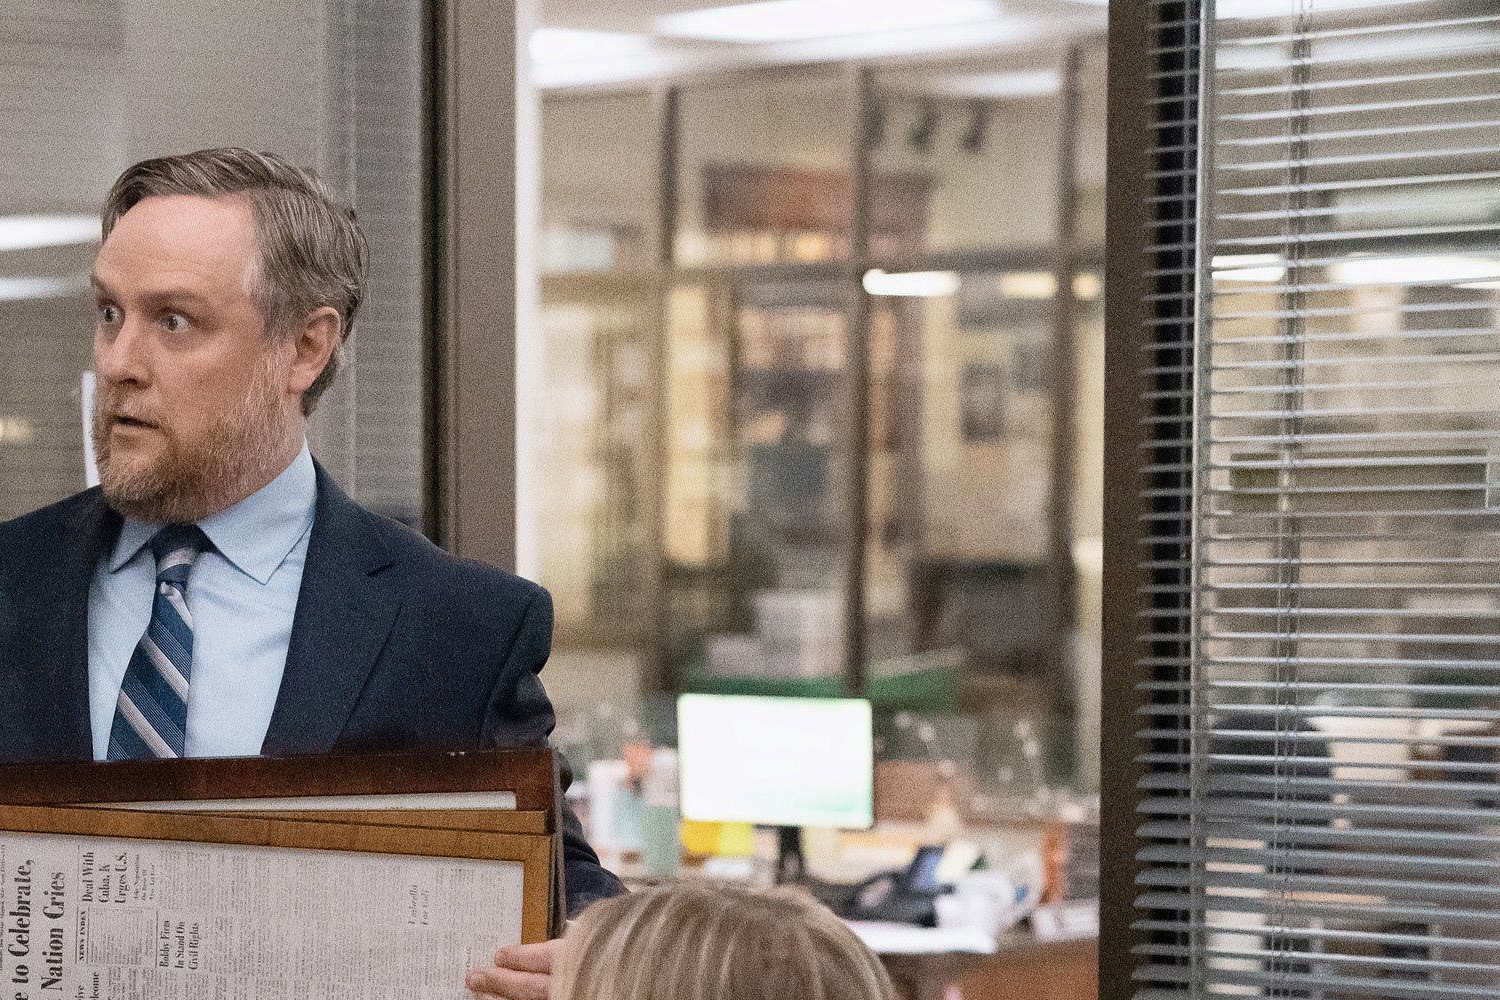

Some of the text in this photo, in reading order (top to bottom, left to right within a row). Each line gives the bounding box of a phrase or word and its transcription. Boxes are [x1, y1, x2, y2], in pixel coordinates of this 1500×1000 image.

[82, 852, 94, 902] Deal With
[99, 864, 110, 872] K
[114, 852, 130, 904] Urges U.S.
[8, 860, 36, 957] Celebrate,
[42, 872, 66, 919] Cries
[40, 928, 63, 991] Nation
[160, 920, 172, 967] Bobby Firm
[174, 922, 185, 968] In Stand On
[188, 922, 201, 970] Civil Rights
[12, 964, 29, 984] to
